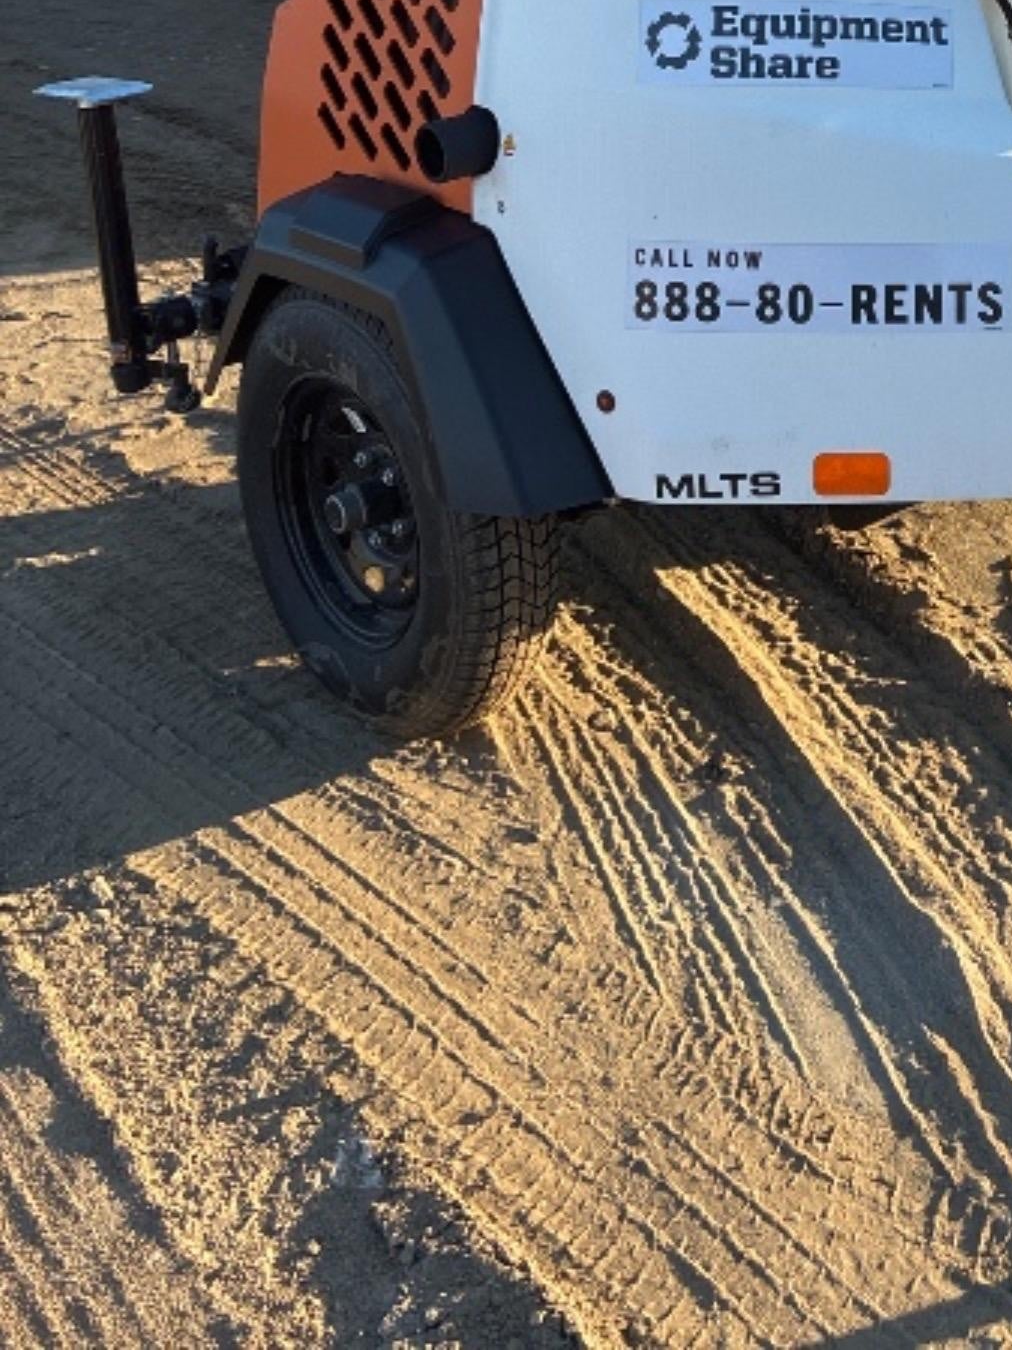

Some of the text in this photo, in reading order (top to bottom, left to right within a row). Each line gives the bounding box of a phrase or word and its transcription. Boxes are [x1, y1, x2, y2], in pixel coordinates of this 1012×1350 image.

[710, 5, 949, 48] Equipment
[710, 45, 840, 79] Share
[634, 247, 763, 270] CALL NOW
[633, 279, 1004, 326] 888-80-RENTS
[655, 471, 781, 500] MLTS
